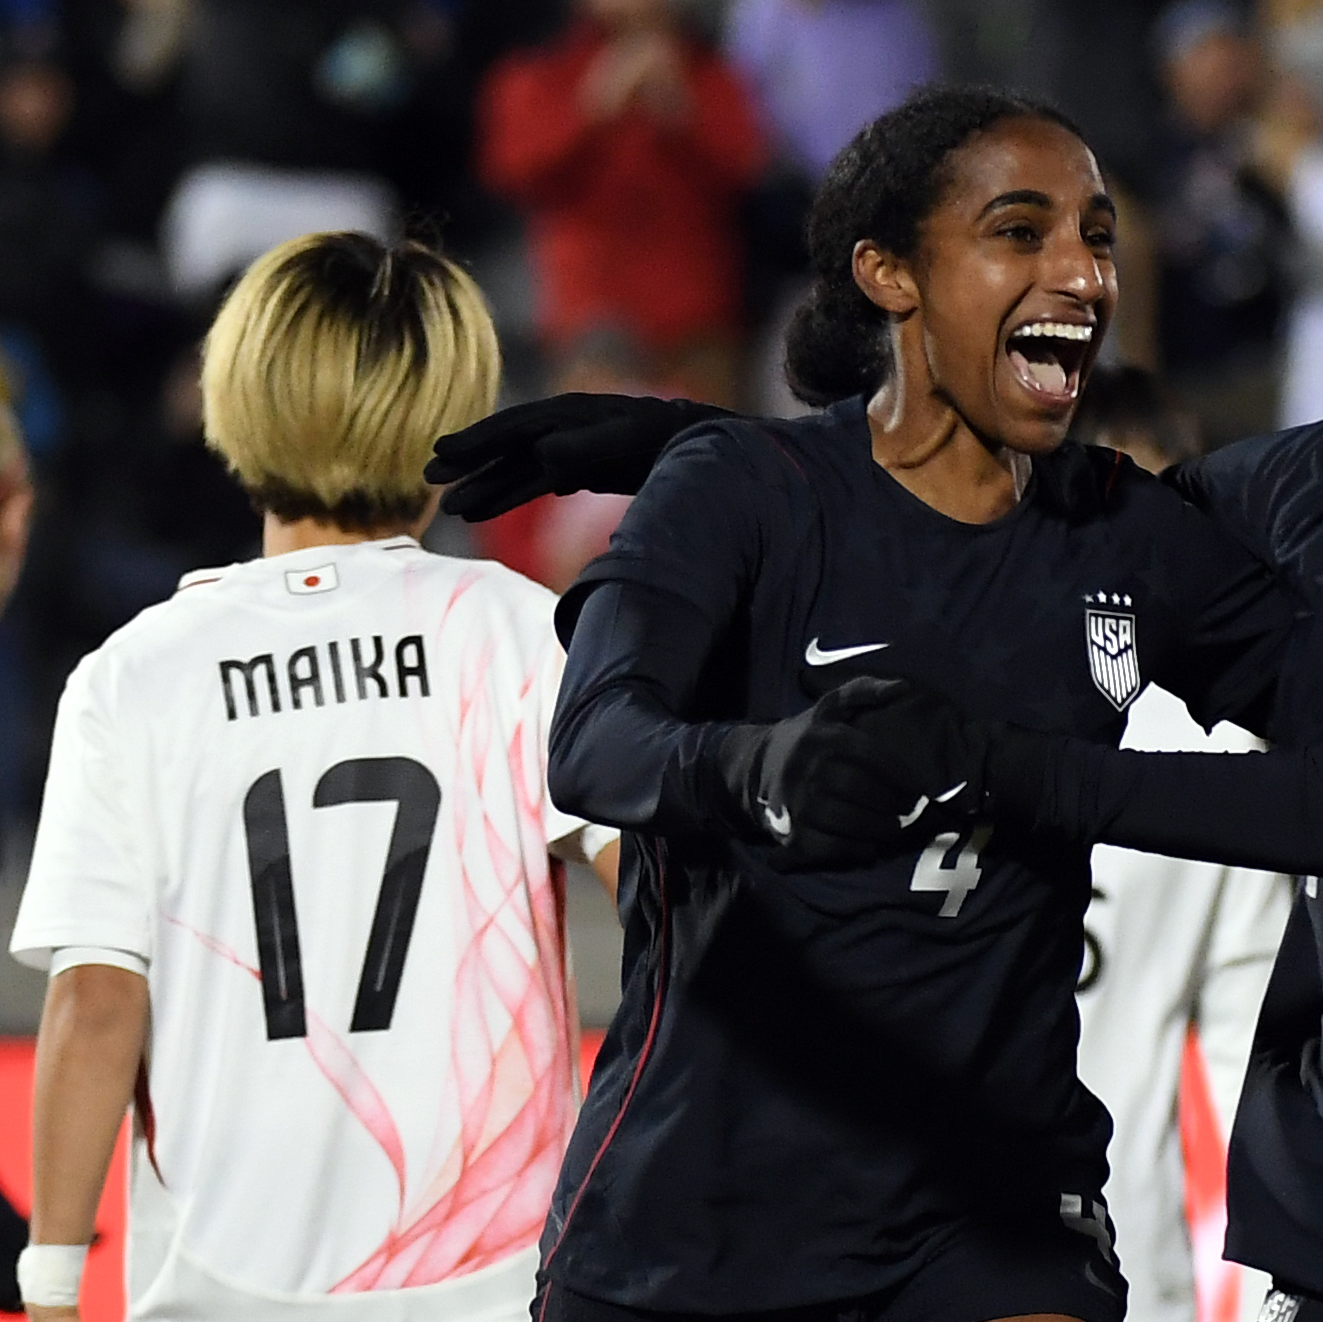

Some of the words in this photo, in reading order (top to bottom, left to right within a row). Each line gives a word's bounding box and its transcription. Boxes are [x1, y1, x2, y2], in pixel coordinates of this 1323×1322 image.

[218, 634, 431, 722] MAIKA
[1090, 615, 1132, 655] USA
[242, 755, 442, 1042] 17
[909, 830, 990, 918] 4
